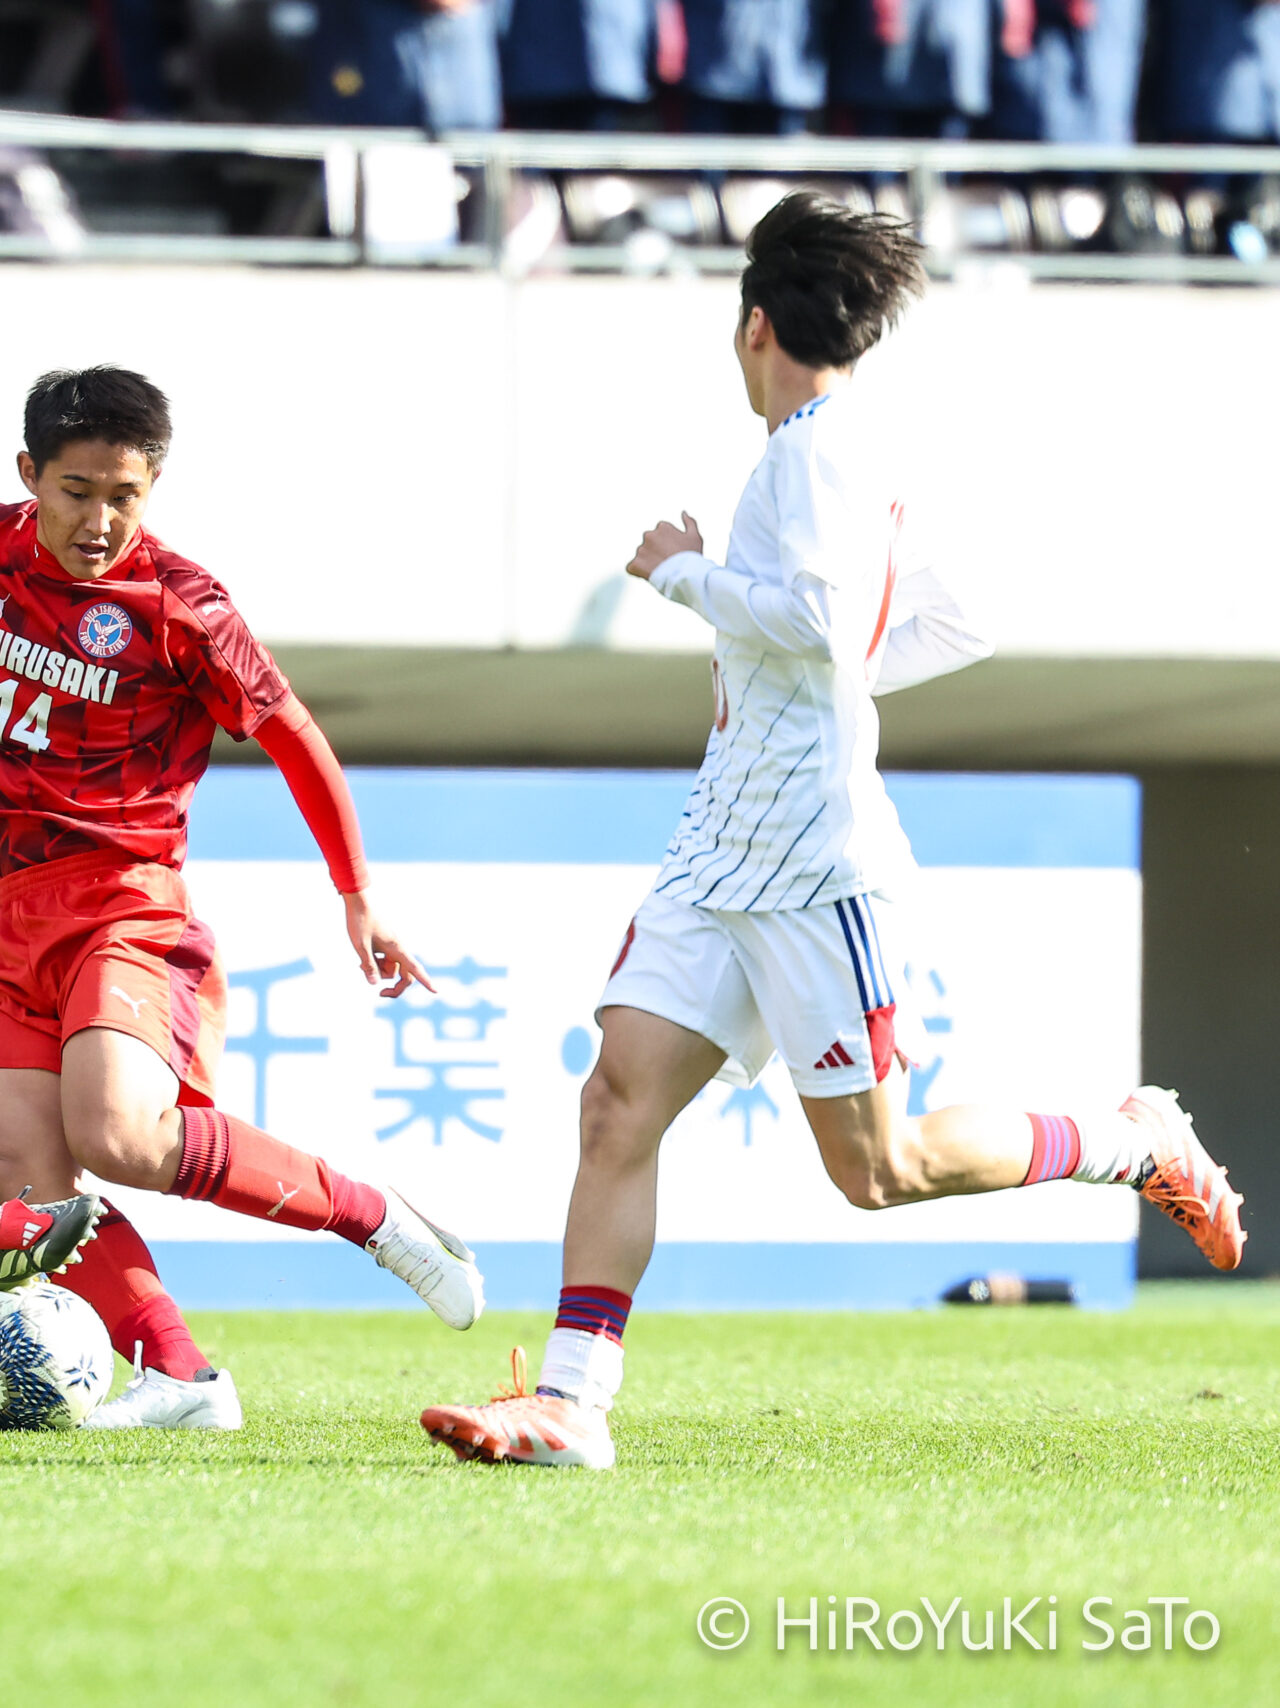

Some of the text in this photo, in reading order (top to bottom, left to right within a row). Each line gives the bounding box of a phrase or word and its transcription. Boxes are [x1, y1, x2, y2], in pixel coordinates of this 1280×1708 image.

[84, 605, 130, 630] OITA TSURUSAKI
[80, 631, 126, 656] FOOT BALL CLUB
